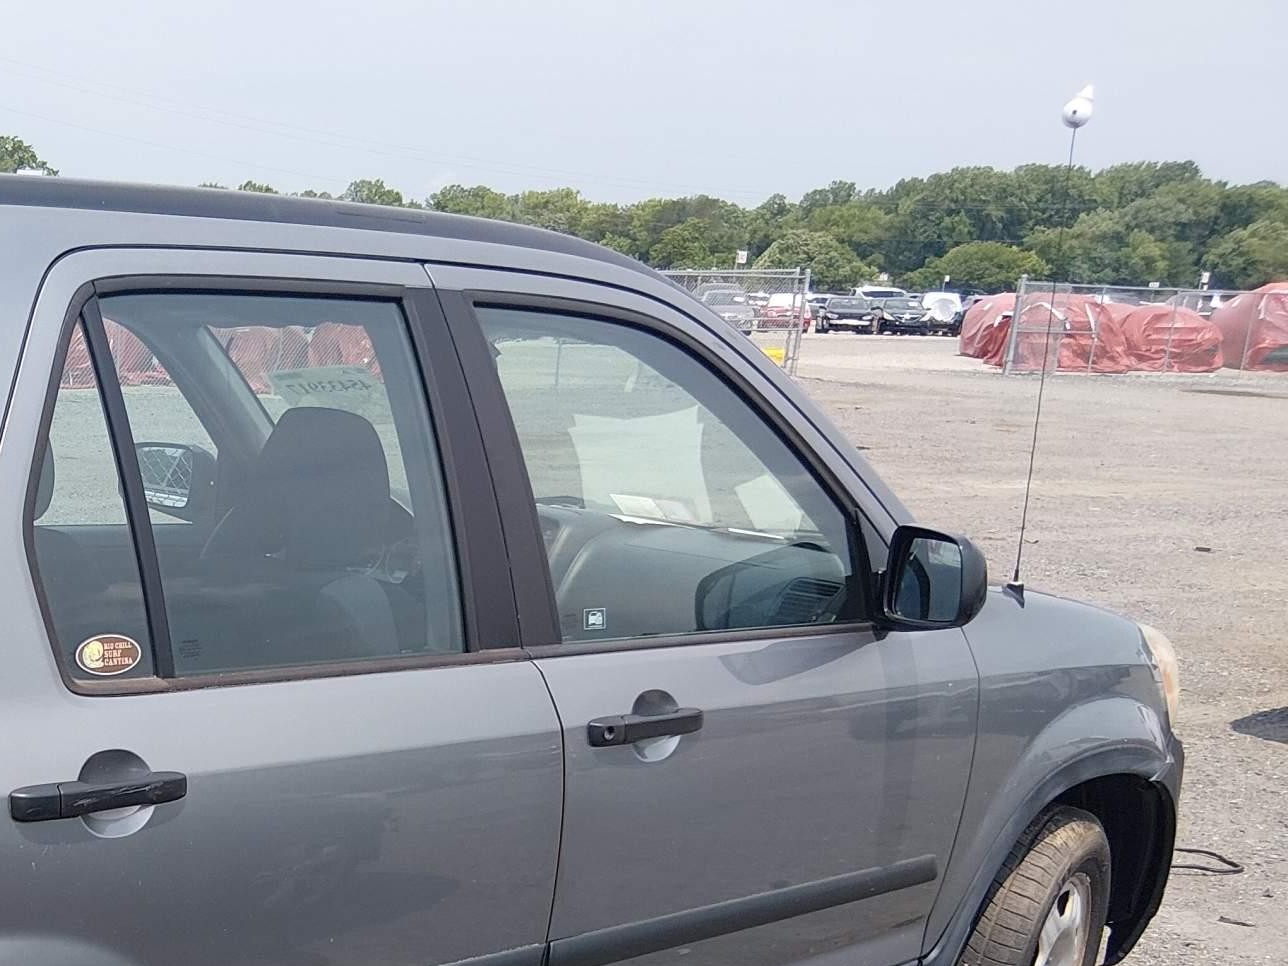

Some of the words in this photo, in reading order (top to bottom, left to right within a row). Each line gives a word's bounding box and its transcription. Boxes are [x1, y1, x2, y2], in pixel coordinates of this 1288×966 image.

[104, 642, 114, 650] BIG
[115, 641, 133, 649] CHILL
[104, 649, 122, 658] SURF
[104, 657, 133, 666] CANTINA
